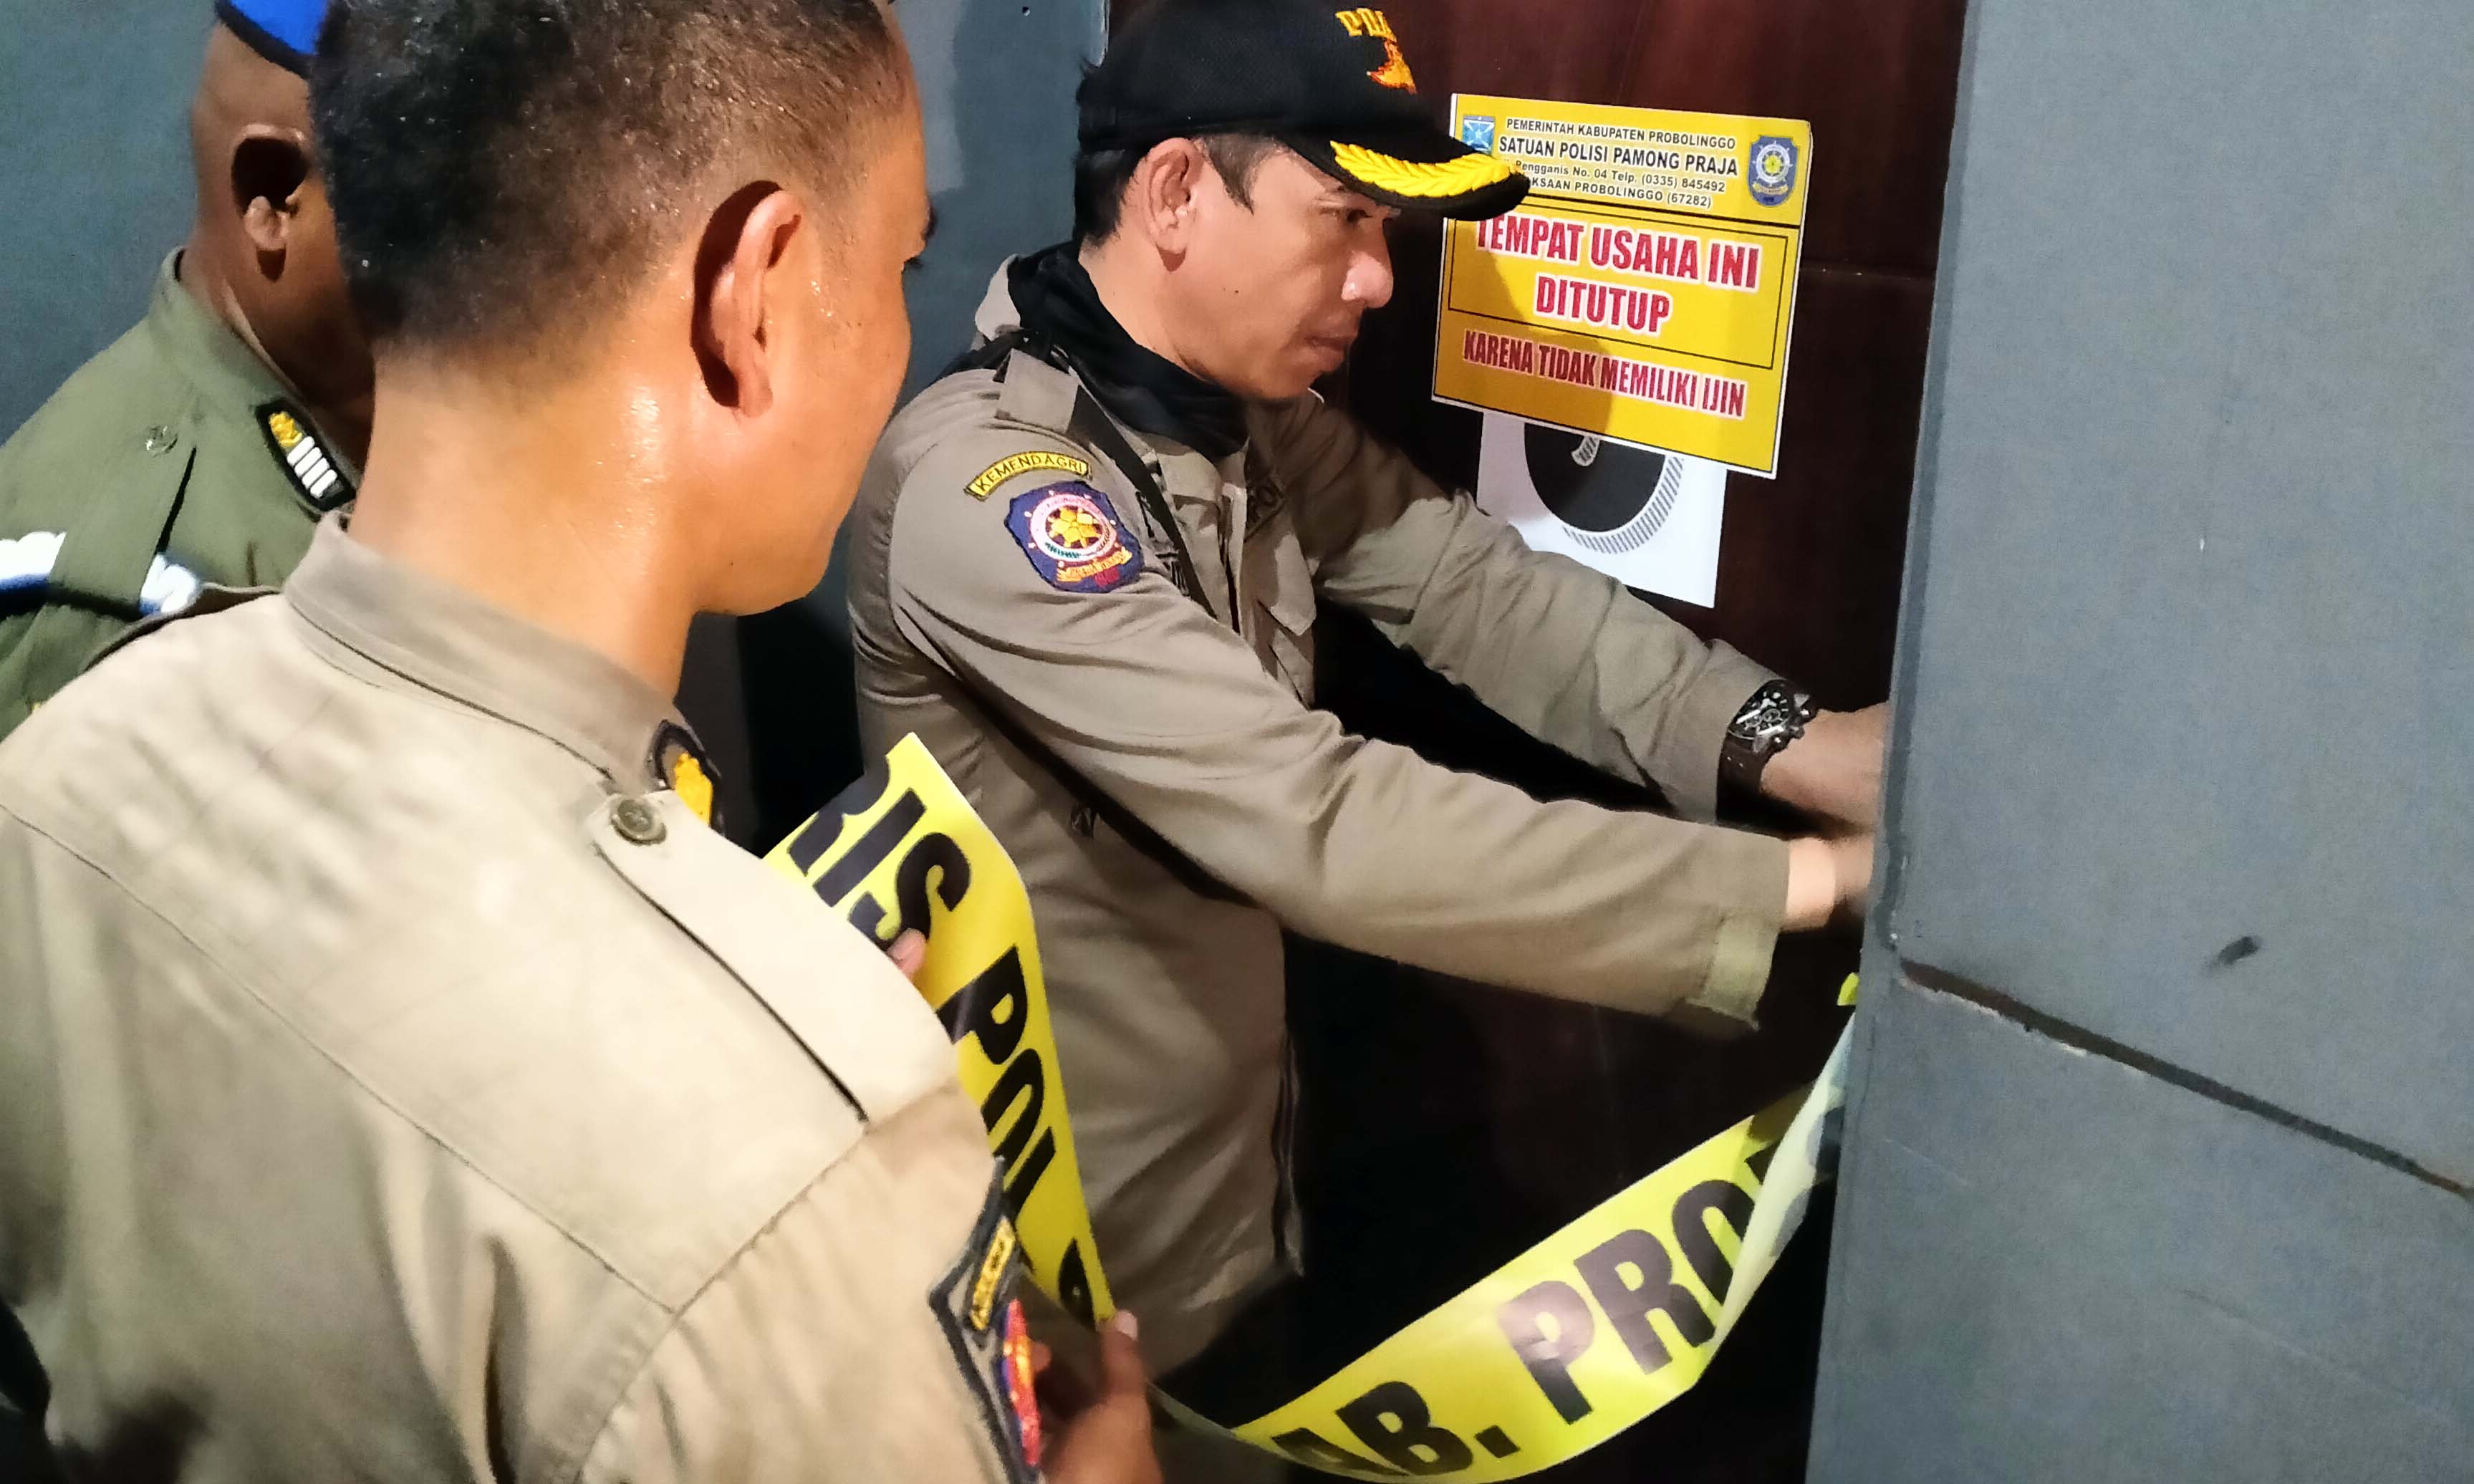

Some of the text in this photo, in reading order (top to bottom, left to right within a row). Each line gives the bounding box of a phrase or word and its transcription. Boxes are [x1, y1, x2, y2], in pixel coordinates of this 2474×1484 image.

[1507, 119, 1736, 149] PEMERINTAH KABUPATEN PROBOLINGGO
[1499, 136, 1738, 176] SATUAN POLISI PAMONG PRAJA
[1572, 166, 1590, 178] No.
[1594, 168, 1607, 179] 04
[1612, 170, 1637, 183] Telp.
[1642, 174, 1678, 188] (0335)
[1682, 178, 1725, 193] 845492
[1575, 182, 1662, 201] PROBOLINGGO
[1667, 194, 1712, 209] (67282)
[1590, 226, 1698, 280] USAHA
[1708, 244, 1759, 288] INI
[1536, 275, 1670, 333] DITUTUP
[1463, 330, 1745, 416] KARENA TIDAK MEMILIKI IJIN
[976, 455, 1083, 491] KEMENDAGRI
